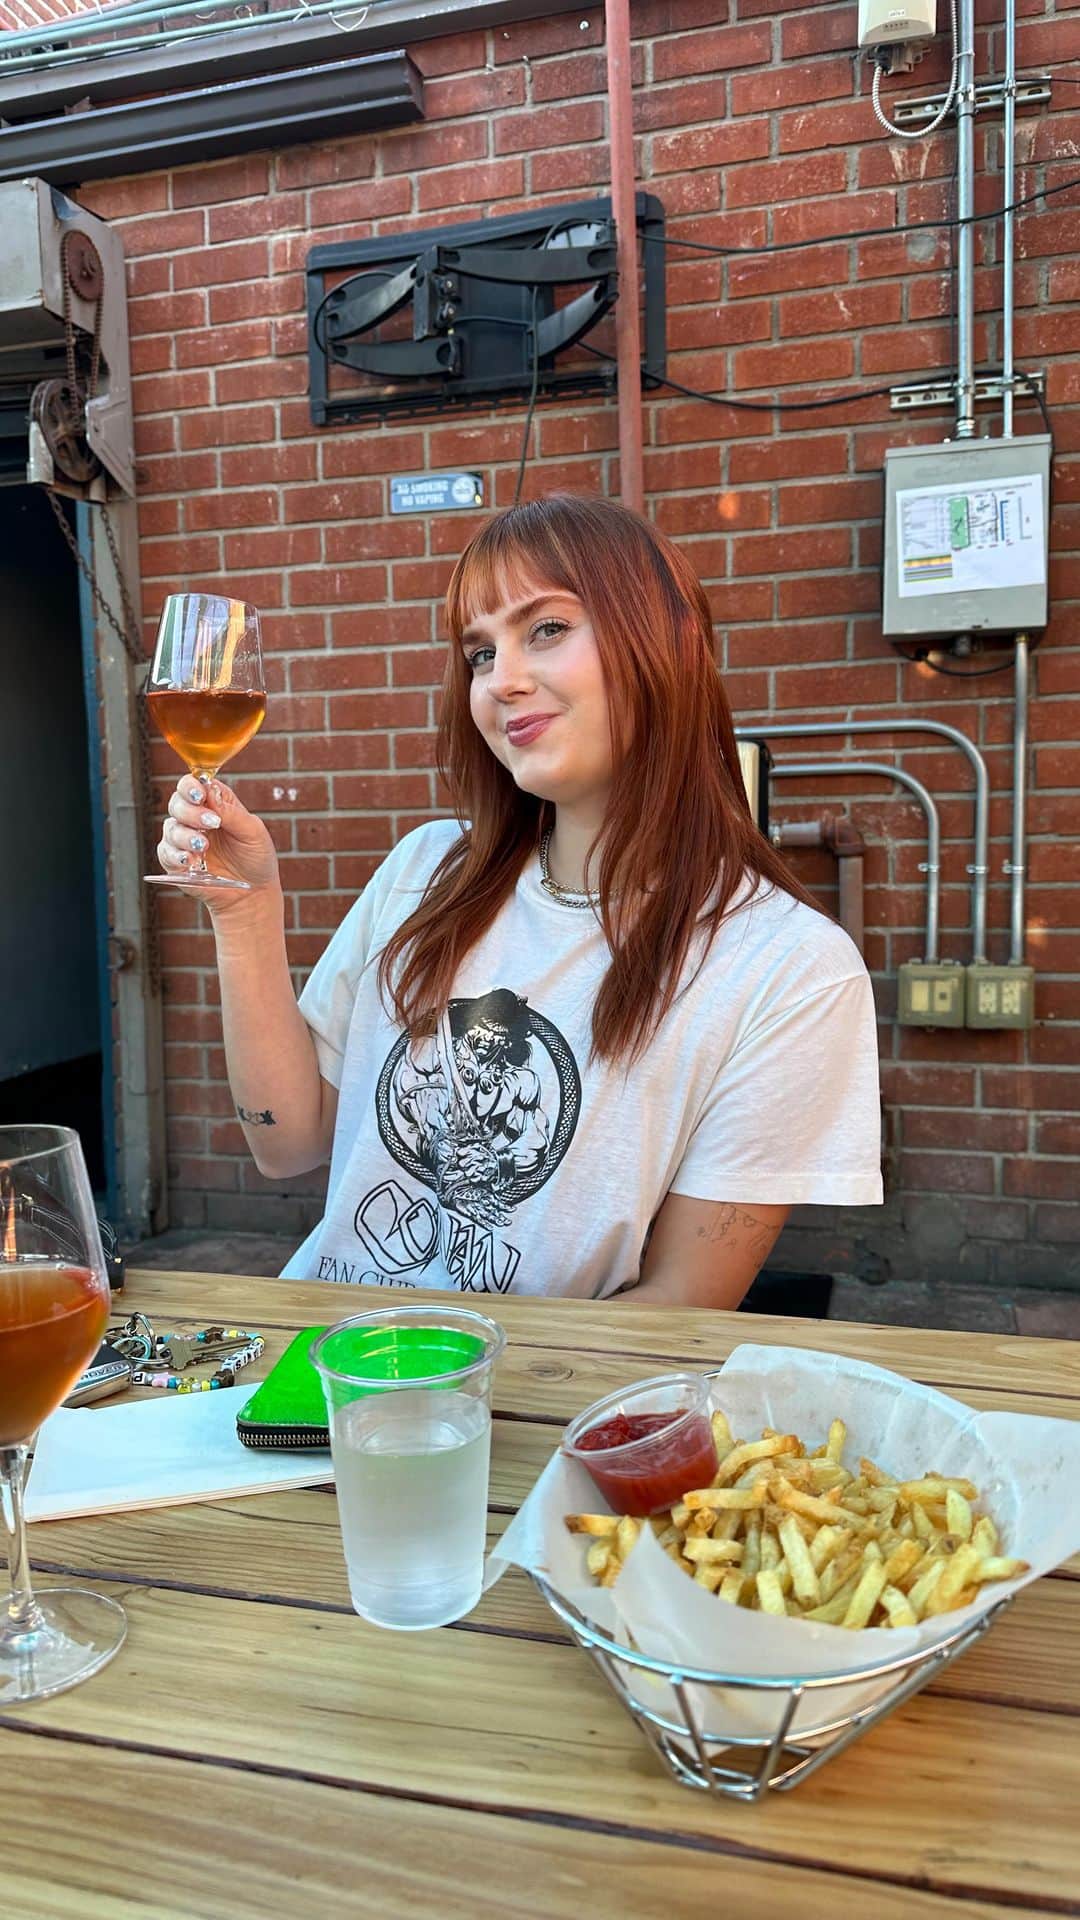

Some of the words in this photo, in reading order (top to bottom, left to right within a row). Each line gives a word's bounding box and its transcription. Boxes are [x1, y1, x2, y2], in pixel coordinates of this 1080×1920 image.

[411, 480, 449, 493] SMOKING
[401, 495, 414, 506] NO
[414, 493, 445, 504] VAPING
[317, 1256, 355, 1283] FAN
